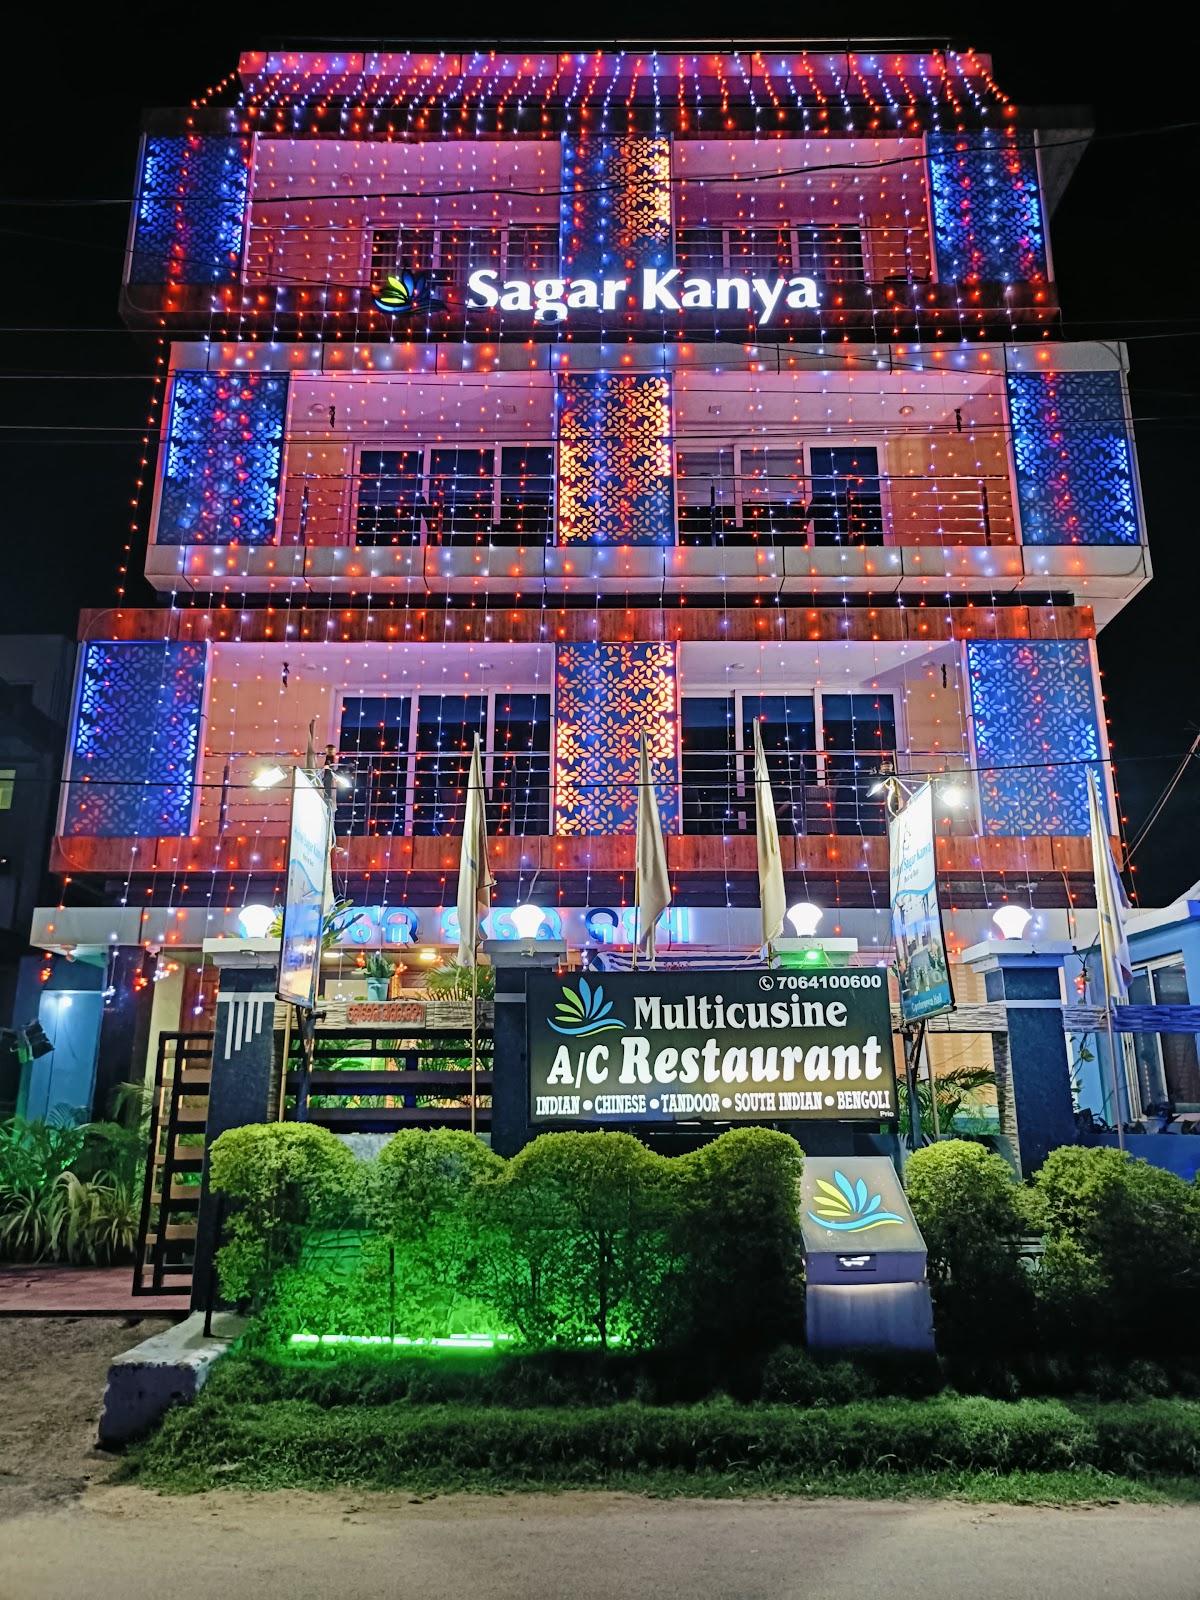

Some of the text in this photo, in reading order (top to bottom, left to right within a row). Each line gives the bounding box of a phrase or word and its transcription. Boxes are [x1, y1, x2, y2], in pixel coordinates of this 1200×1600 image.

[466, 268, 822, 326] Sagar Kanya
[777, 975, 882, 989] 7064100600
[633, 994, 848, 1030] Multicusine
[546, 1035, 883, 1089] A/C Restaurant
[535, 1089, 891, 1116] INDIAN CHINESE TANDOOR SOUTH INDIAN BENGOLI
